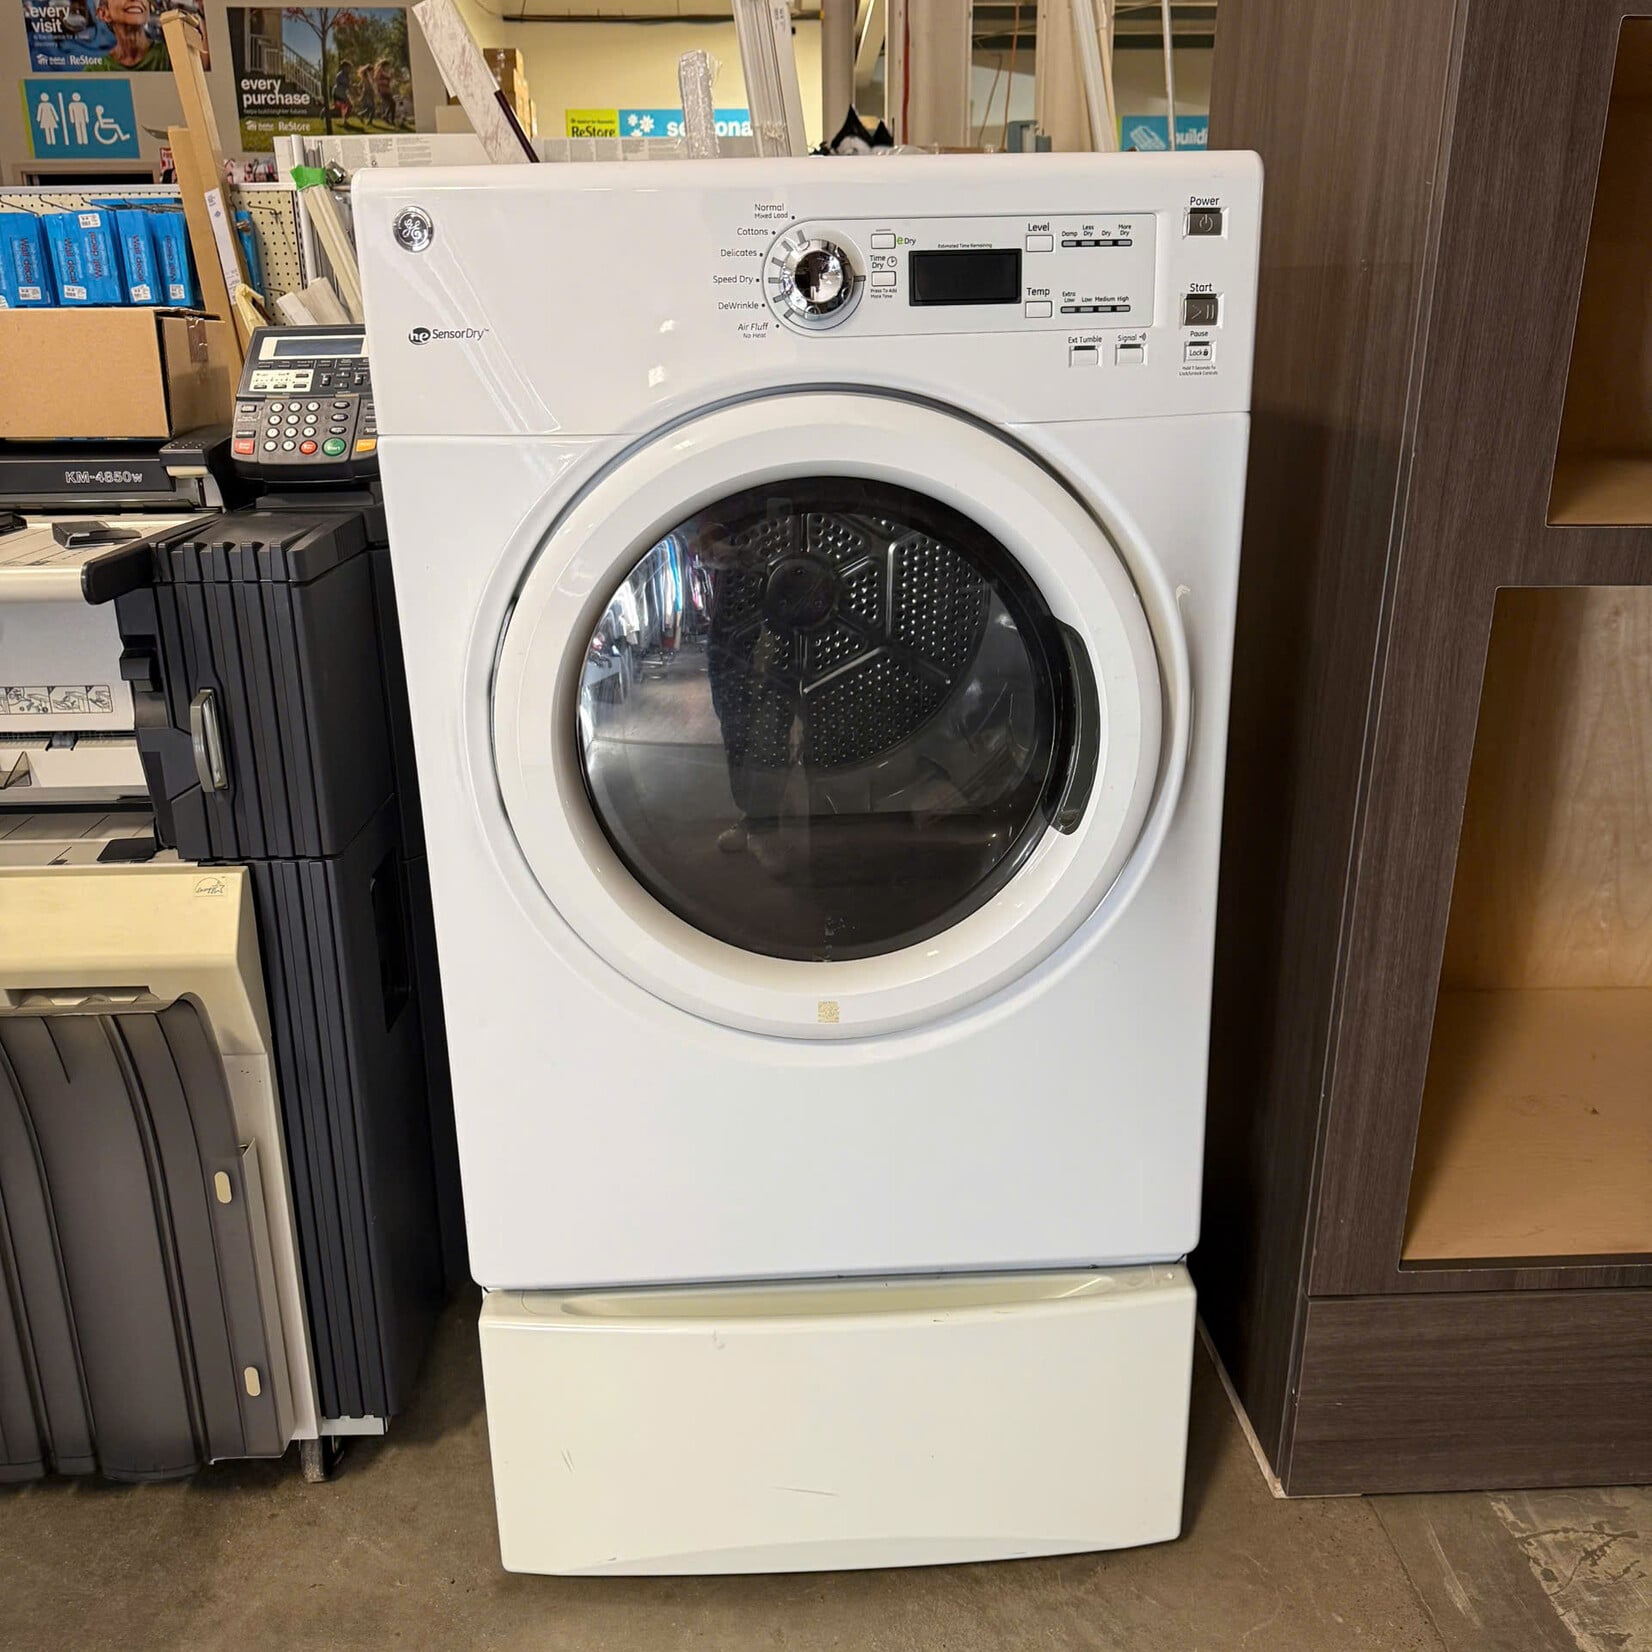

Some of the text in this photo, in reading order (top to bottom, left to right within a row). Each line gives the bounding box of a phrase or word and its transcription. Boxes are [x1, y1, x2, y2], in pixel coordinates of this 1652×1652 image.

[30, 6, 70, 20] every
[31, 18, 62, 33] visit
[69, 54, 103, 65] ReStore
[241, 78, 281, 92] every
[242, 91, 311, 108] purchase
[278, 121, 311, 132] ReStore
[571, 125, 616, 138] ReStore
[1190, 196, 1220, 206] Power
[754, 203, 784, 212] Normal
[1027, 222, 1050, 231] Level
[736, 227, 769, 236] Cottons
[720, 248, 758, 257] Delicates
[869, 254, 886, 262] Time
[871, 261, 884, 270] Dry
[712, 275, 754, 285] Speed Dry
[1026, 287, 1051, 297] Temp
[1189, 283, 1212, 292] Start
[718, 301, 759, 310] DeWrinkle
[737, 322, 768, 331] Air Fluff
[1079, 335, 1102, 343] Tumble
[1117, 334, 1137, 342] Signal
[65, 470, 143, 484] KM-4850w
